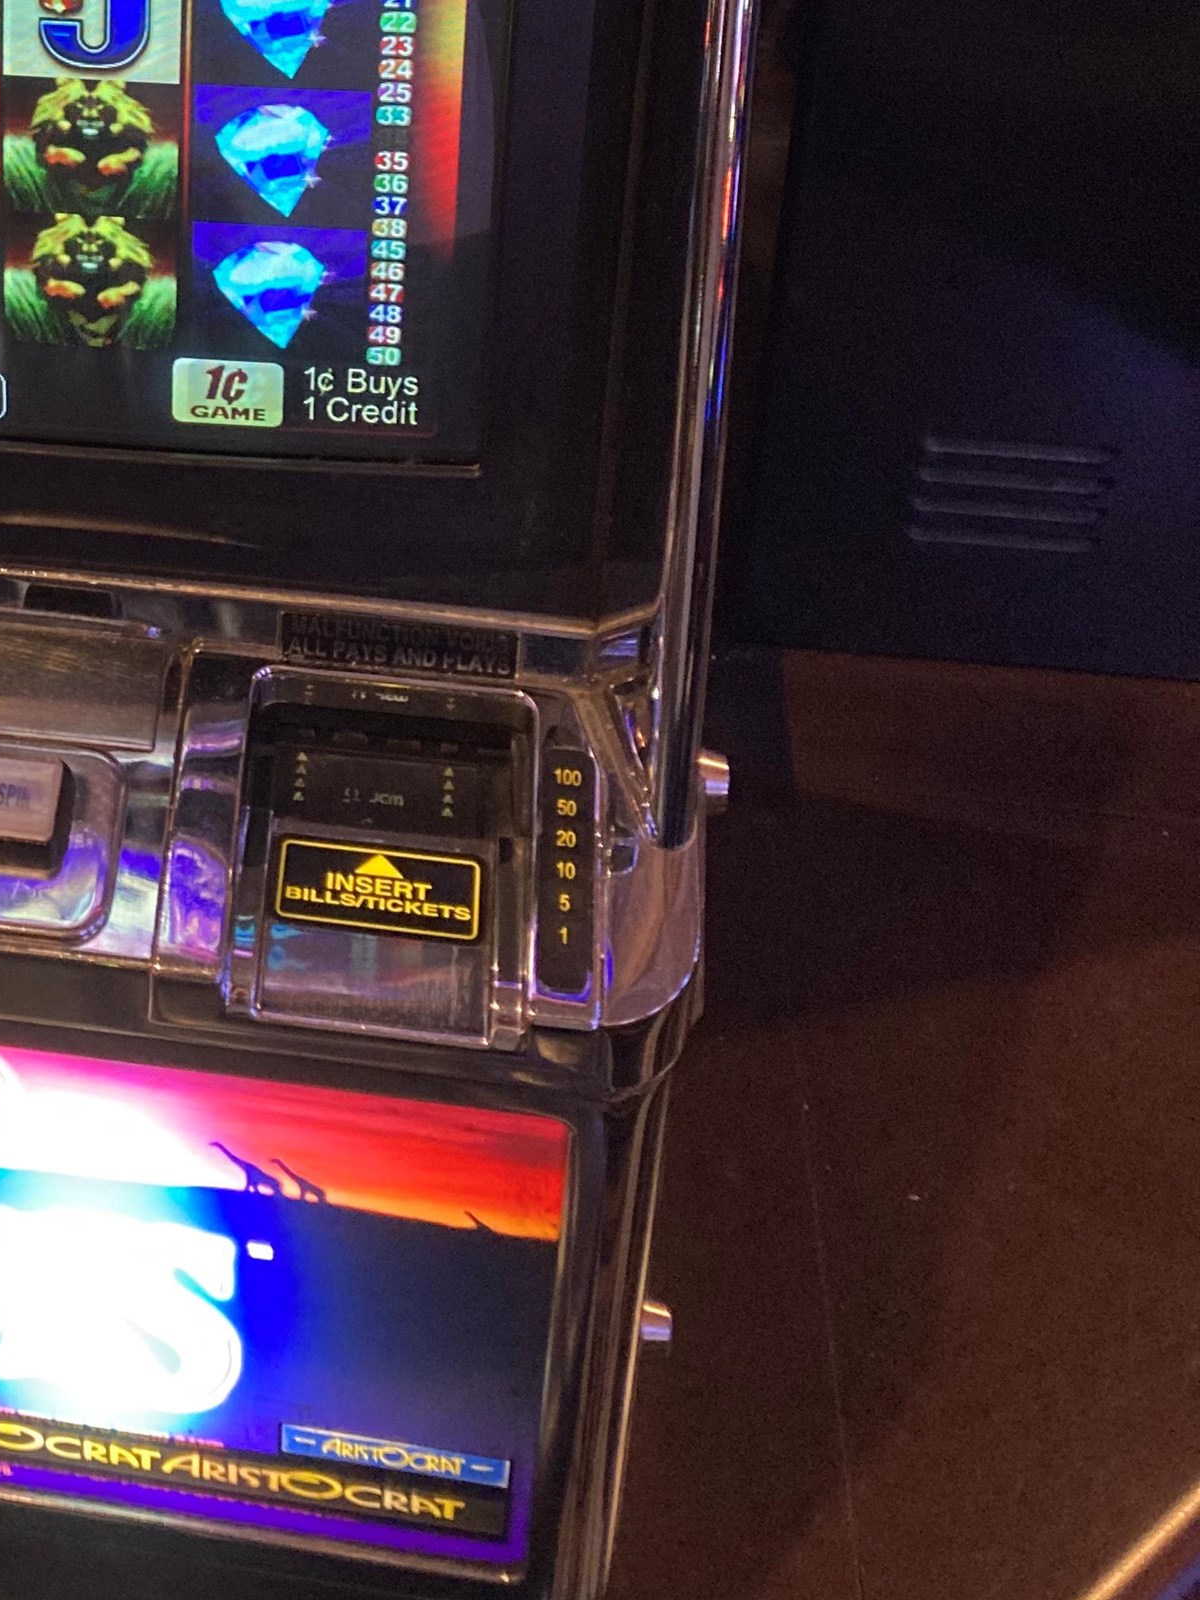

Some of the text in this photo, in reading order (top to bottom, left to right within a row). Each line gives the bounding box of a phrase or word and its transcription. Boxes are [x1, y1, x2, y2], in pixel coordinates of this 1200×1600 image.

[382, 36, 414, 56] 23
[375, 196, 407, 215] 37
[370, 283, 403, 302] 47
[369, 325, 400, 344] 49
[205, 365, 248, 405] 1¢
[303, 367, 419, 401] 1¢ Buys
[190, 405, 265, 422] GAME
[303, 397, 418, 426] 1 Credit
[394, 647, 436, 667] AND
[554, 769, 582, 787] 100
[557, 800, 576, 816] 50
[556, 831, 576, 848] 20
[557, 863, 575, 879] 10
[327, 872, 432, 900] INSERT
[285, 885, 471, 922] BILLS/TICKETS
[559, 895, 570, 912] 5
[559, 927, 568, 943] 1
[322, 1437, 467, 1477] ARISTOCRAT
[162, 1453, 465, 1521] ARISTOCRAT
